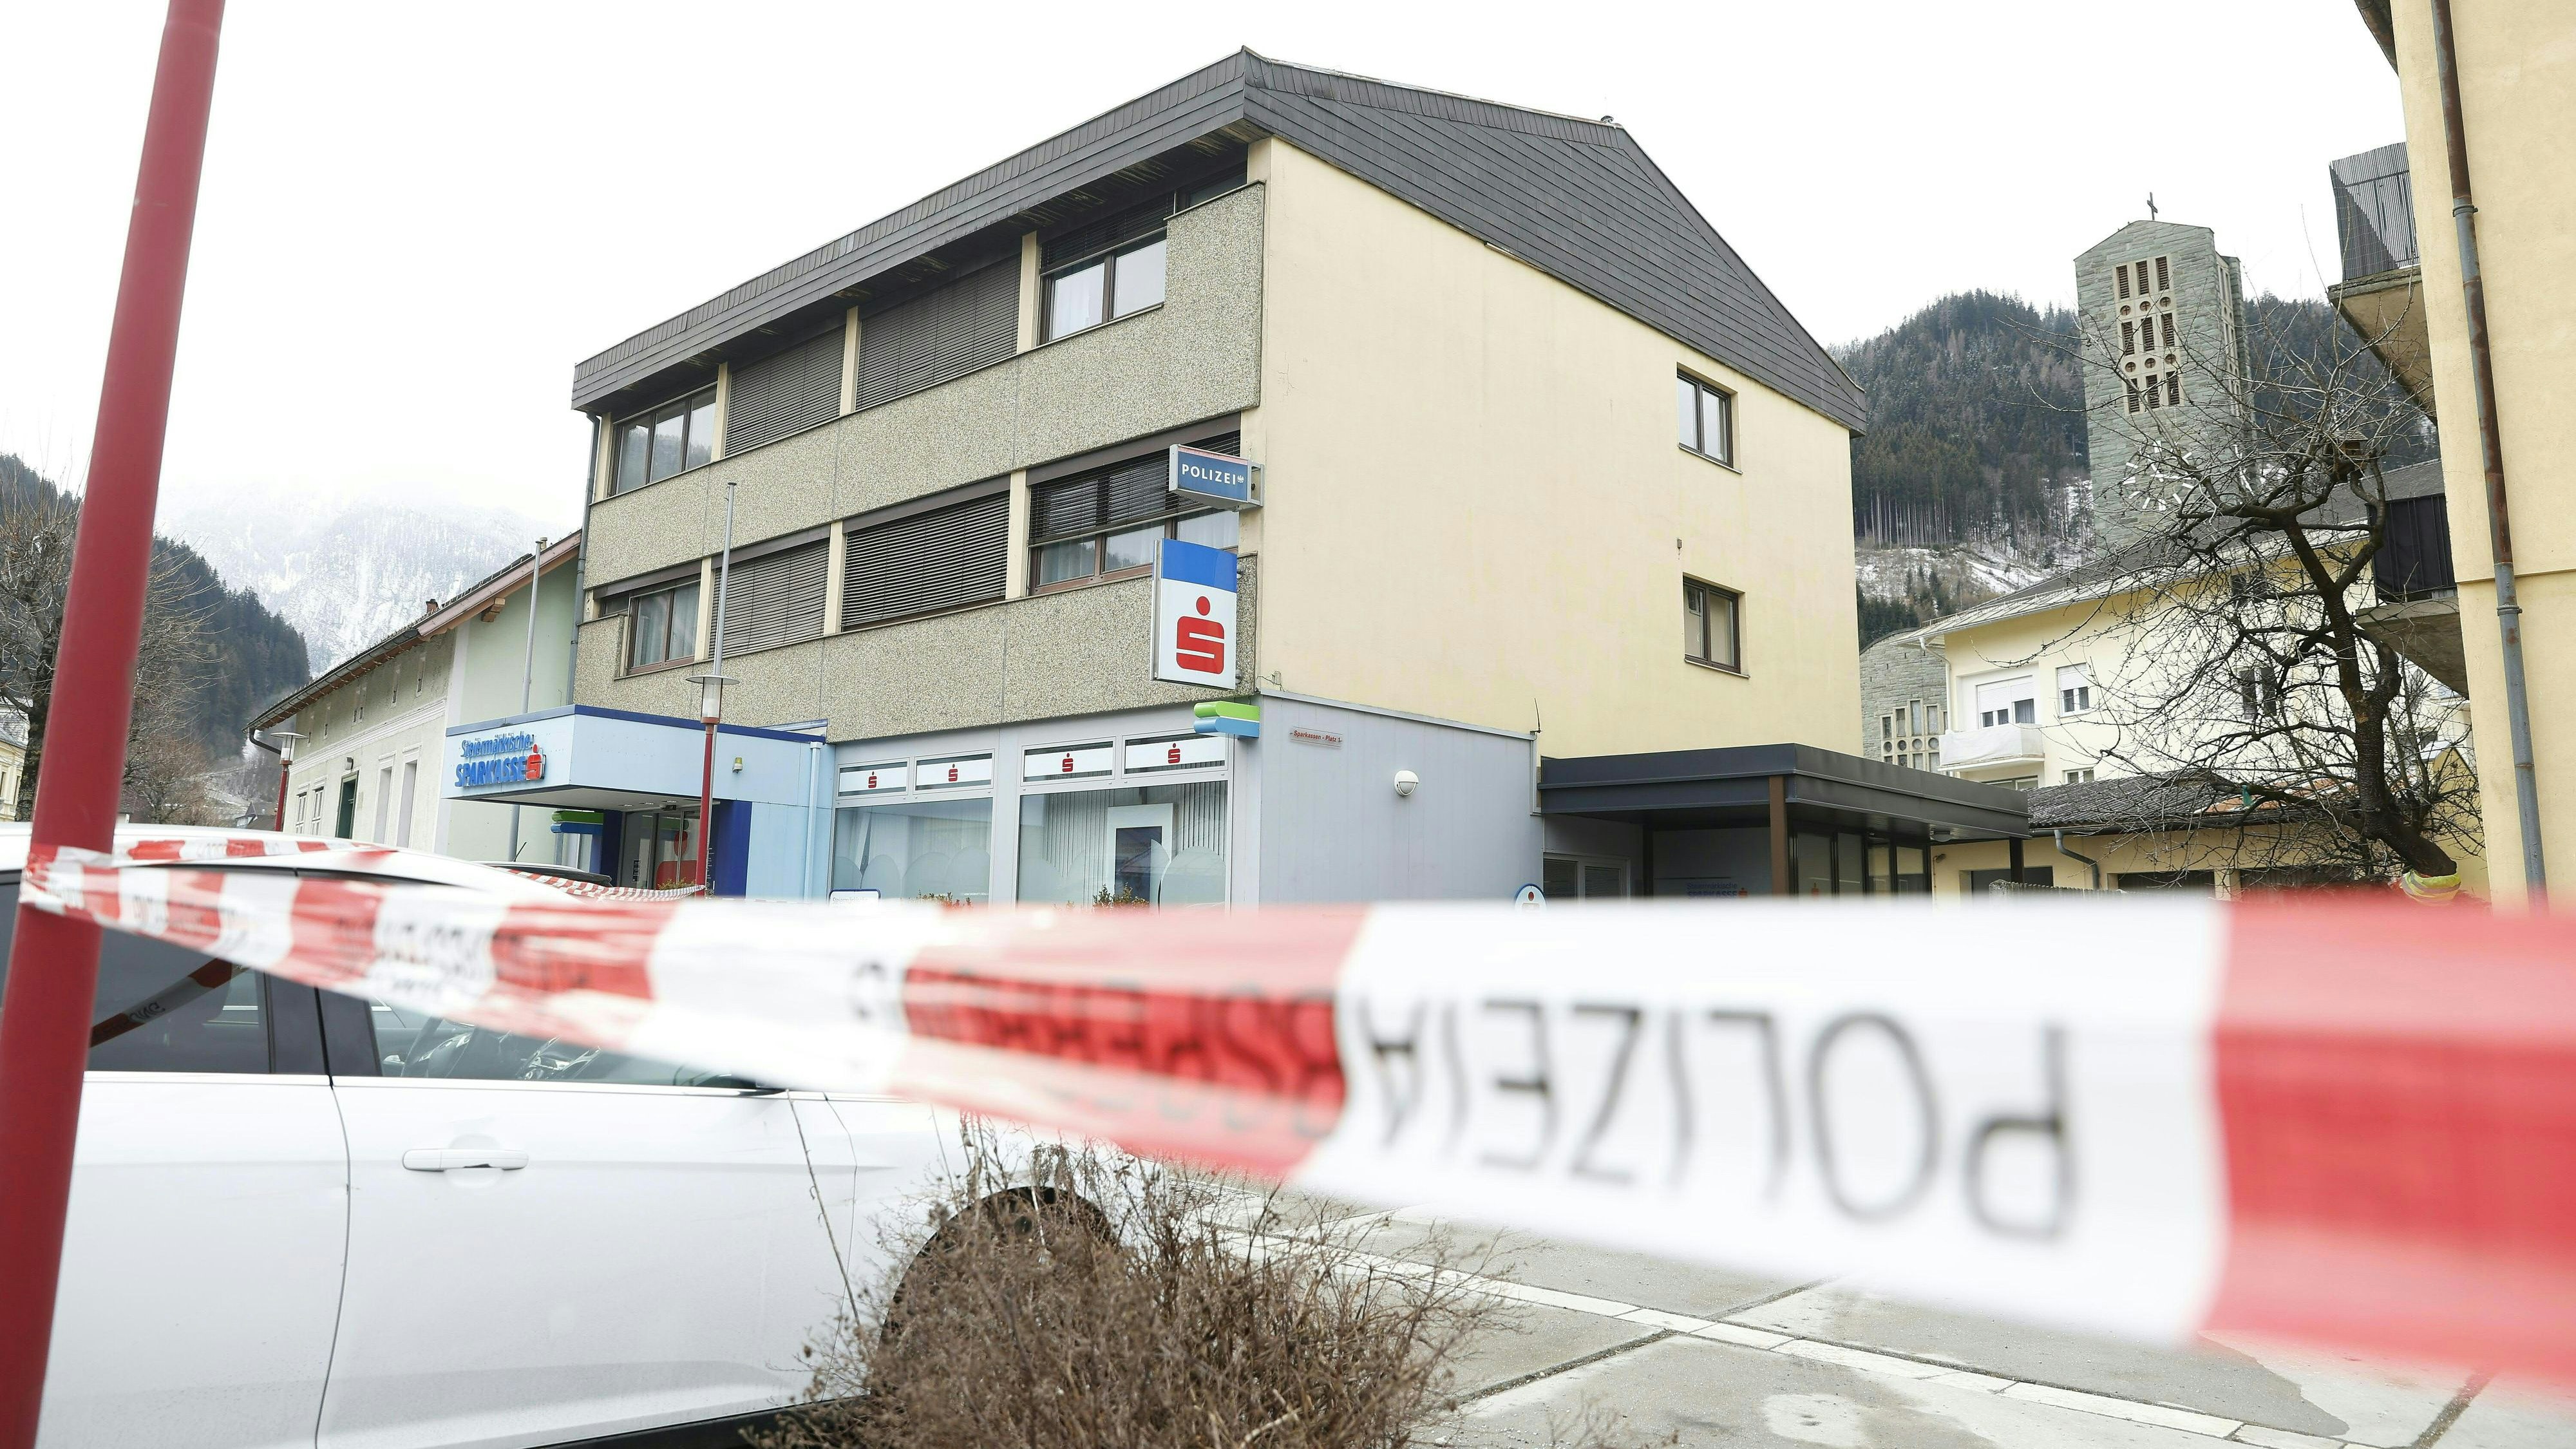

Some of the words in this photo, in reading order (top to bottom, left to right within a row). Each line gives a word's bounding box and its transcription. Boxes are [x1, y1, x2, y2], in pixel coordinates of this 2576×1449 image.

[1182, 464, 1236, 485] POLIZEI
[1294, 730, 1321, 740] Sparkassen
[455, 755, 527, 788] SPARKASSE
